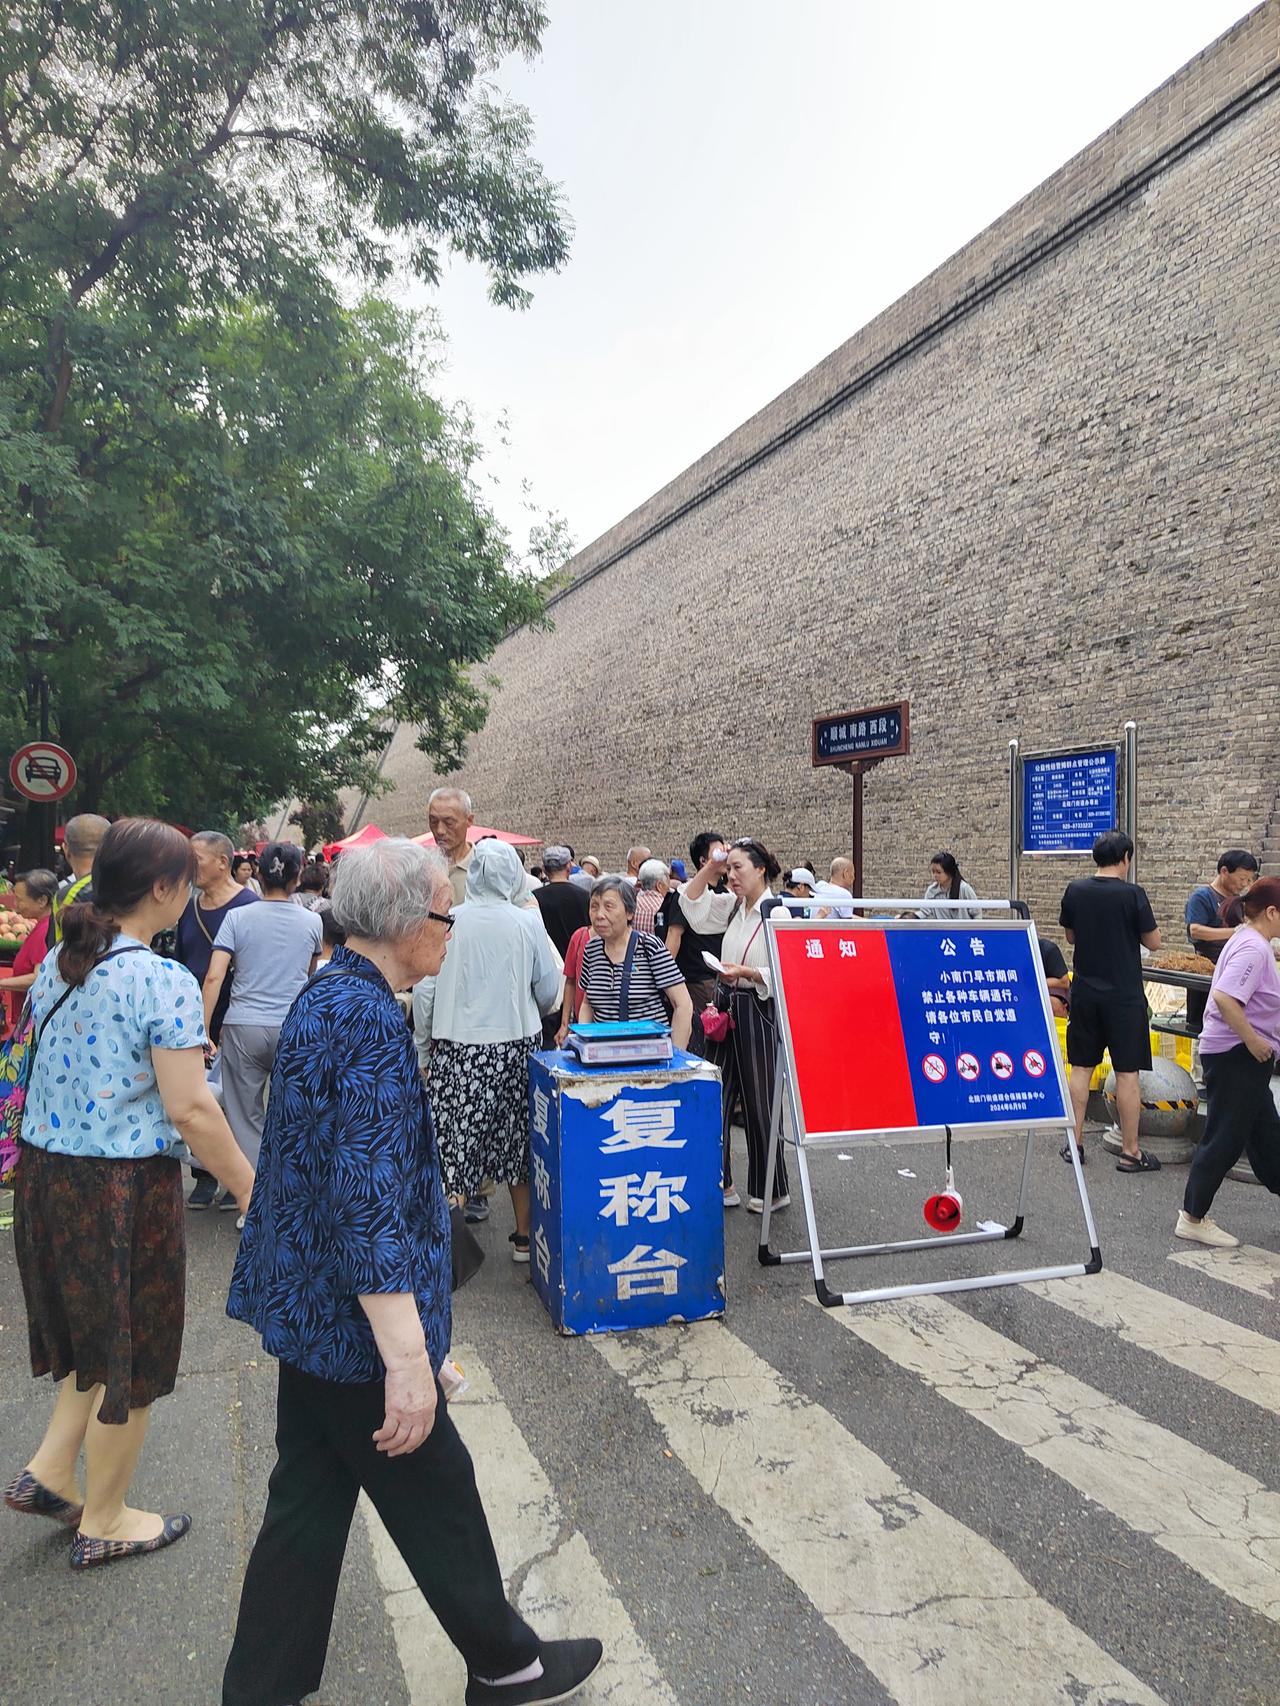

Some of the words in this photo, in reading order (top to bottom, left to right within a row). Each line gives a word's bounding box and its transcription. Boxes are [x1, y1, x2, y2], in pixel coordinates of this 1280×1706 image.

[855, 740, 870, 751] NANLU
[871, 737, 888, 748] XIDUAN
[805, 938, 857, 959] 通知
[940, 937, 985, 957] 公告
[940, 969, 1018, 984] 小南门早市期间
[598, 1098, 691, 1301] 复称台
